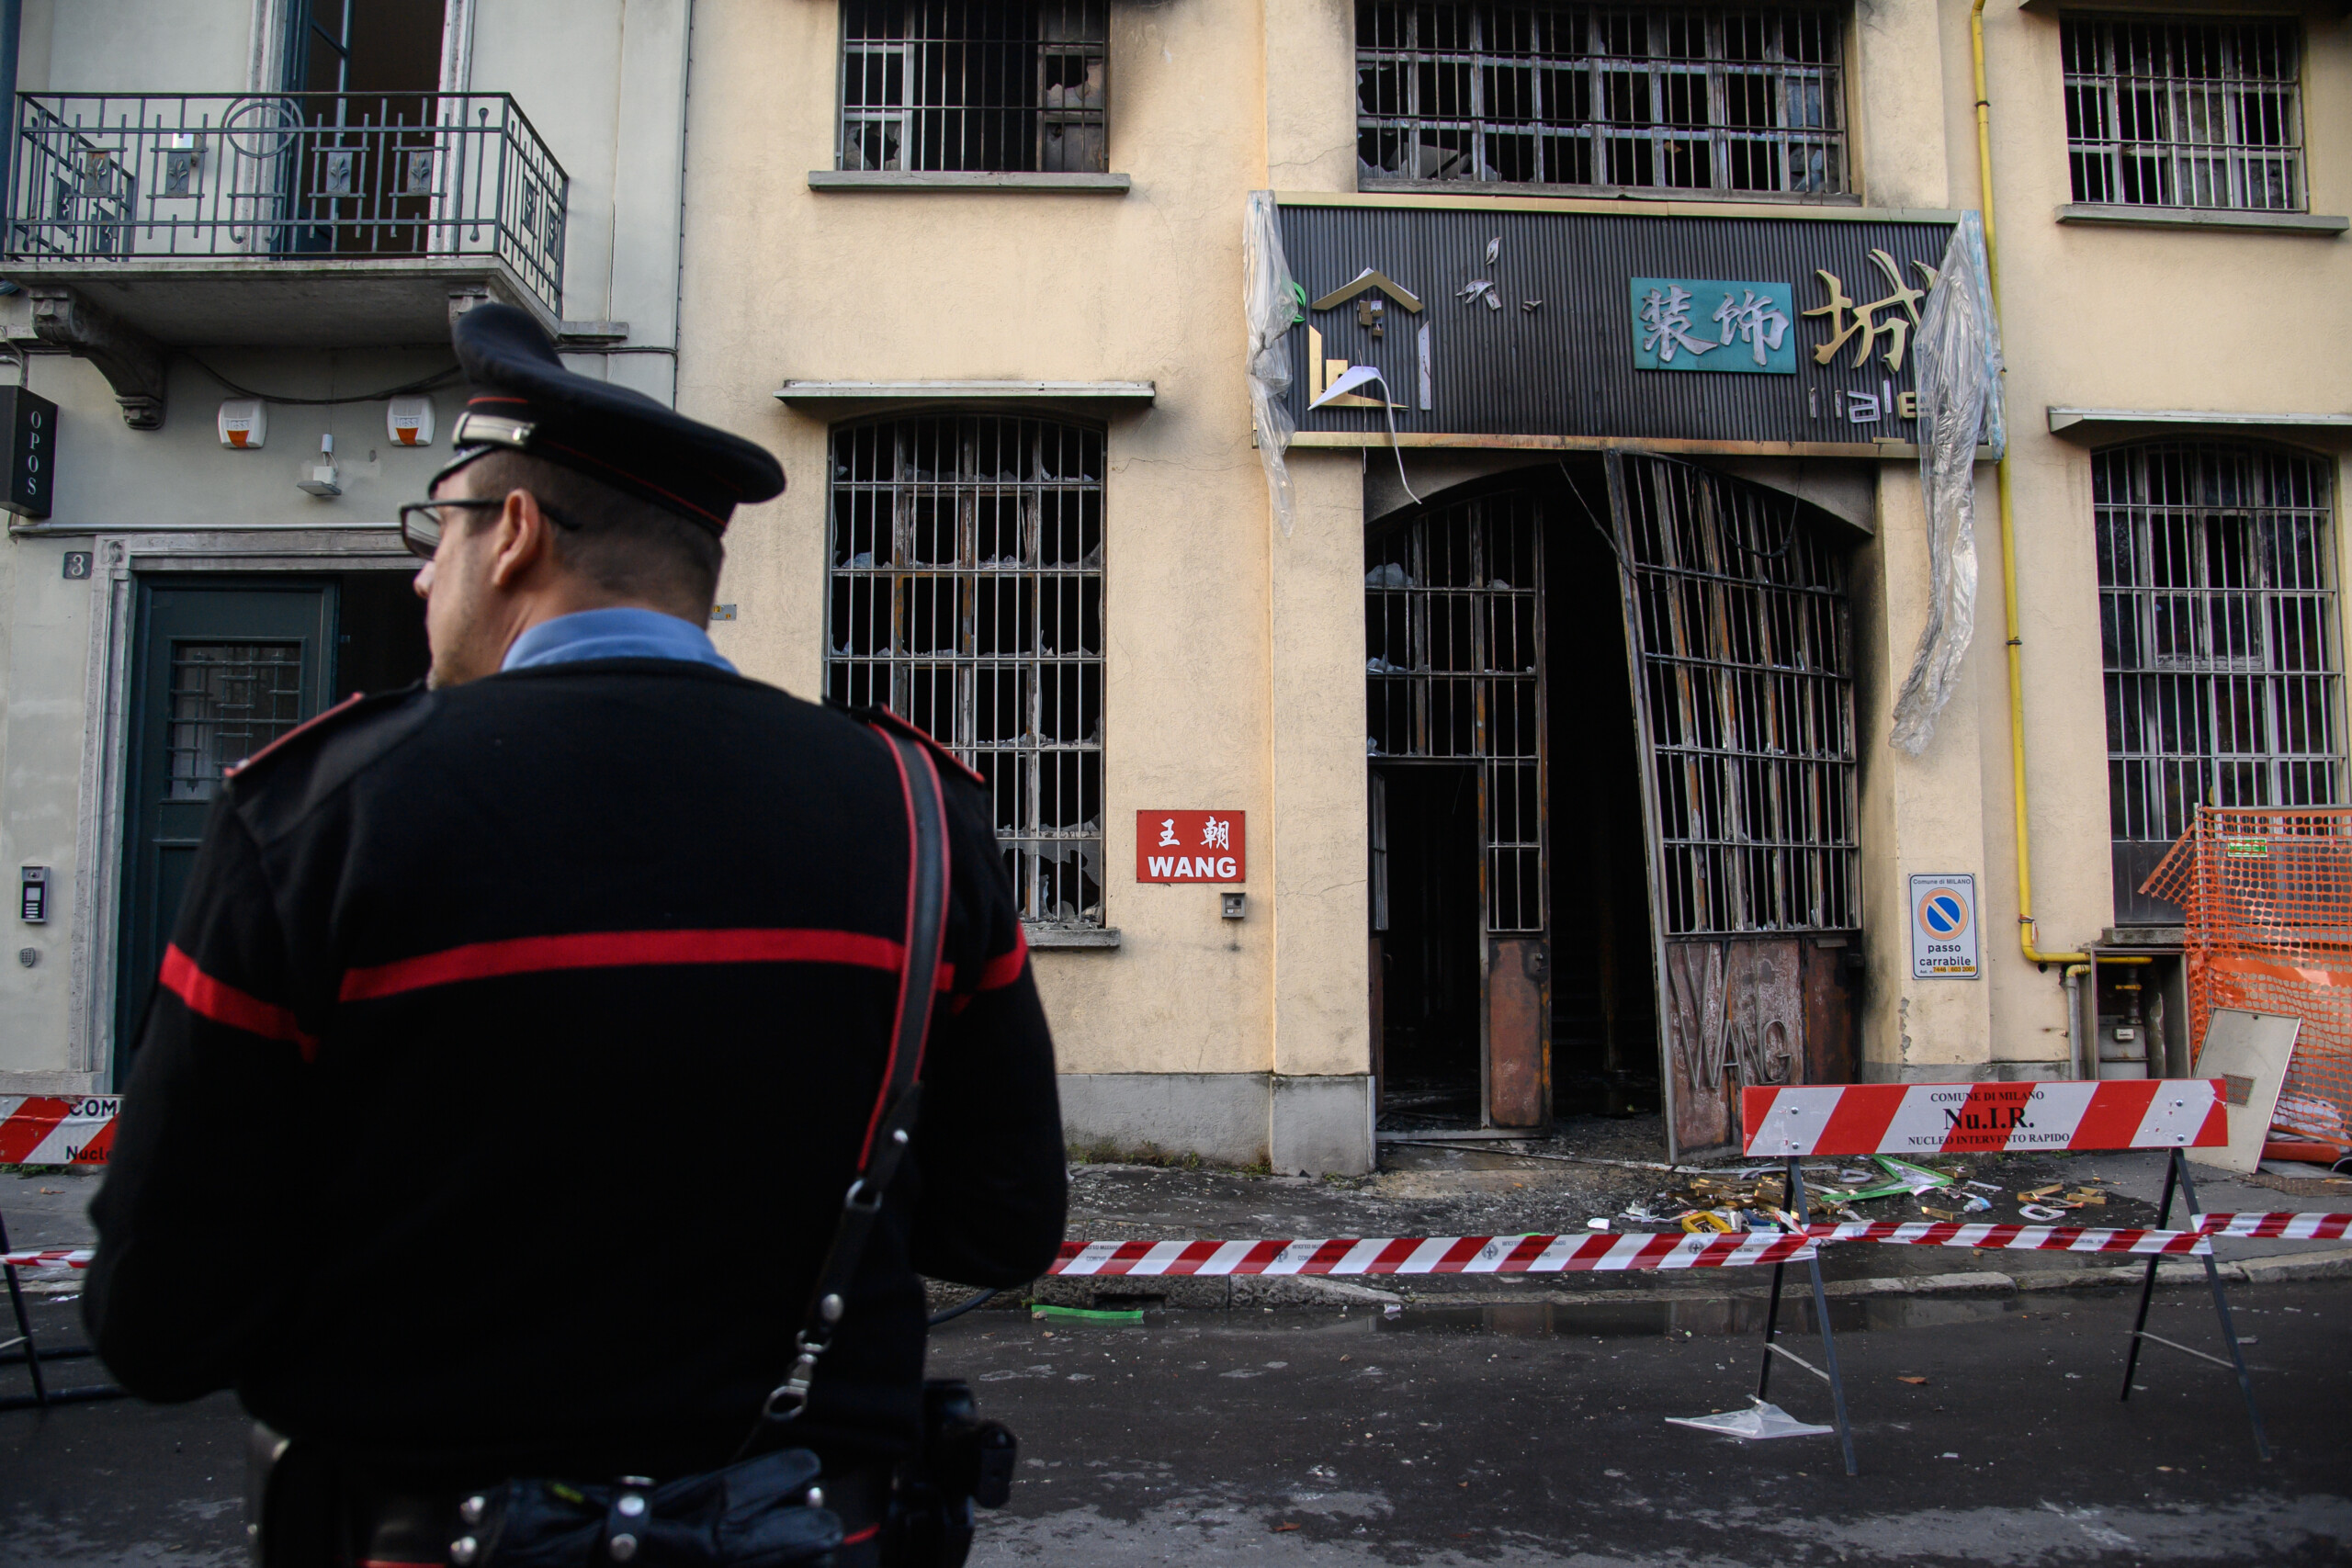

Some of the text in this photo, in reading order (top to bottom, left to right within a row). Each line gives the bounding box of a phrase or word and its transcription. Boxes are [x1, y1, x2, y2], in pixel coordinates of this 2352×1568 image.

[28, 411, 41, 495] OPOS
[72, 554, 85, 576] 3
[1148, 856, 1237, 878] WANG
[1928, 944, 1962, 953] passo
[1919, 956, 1972, 966] carrabile
[1666, 941, 1792, 1089] WANG
[1930, 1091, 2044, 1101] COMUNE DI MILANO
[1942, 1107, 2035, 1130] Nu.I.R.
[1908, 1133, 2070, 1145] NUCLEO INTERVENTO RAPIDO
